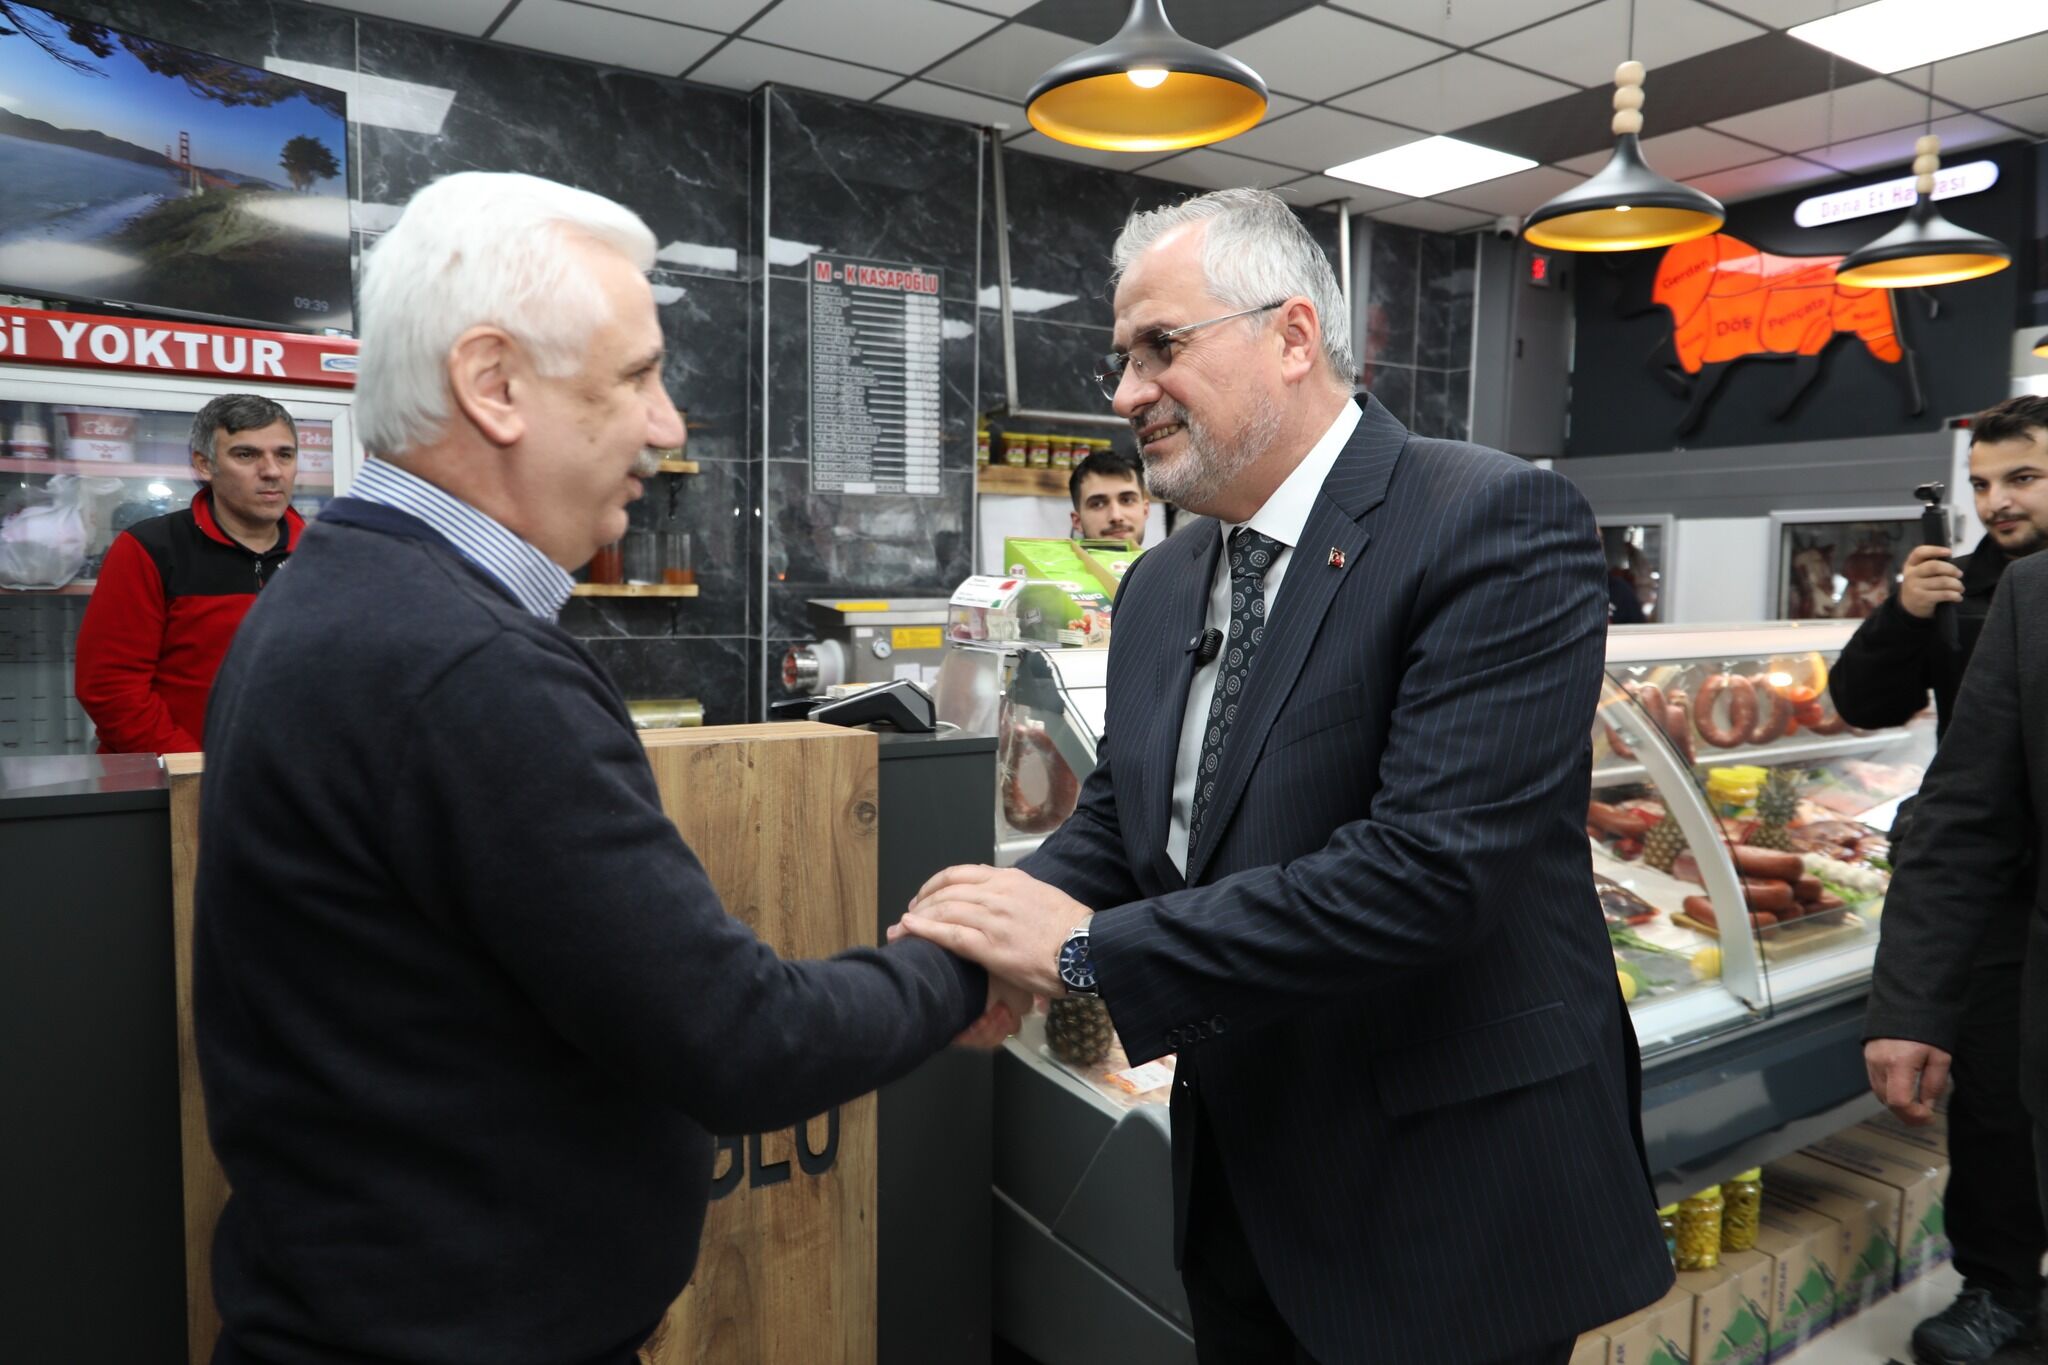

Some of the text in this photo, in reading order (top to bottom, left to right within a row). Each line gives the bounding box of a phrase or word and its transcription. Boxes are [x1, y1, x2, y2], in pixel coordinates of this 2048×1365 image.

[1820, 199, 1861, 219] Dana
[1868, 190, 1884, 209] Et
[815, 260, 832, 282] M
[844, 264, 858, 285] K
[858, 266, 939, 294] KASAPOĞLU
[1661, 258, 1710, 291] Gerdan
[293, 295, 330, 314] 09:39
[1716, 314, 1753, 338] Döş
[47, 318, 287, 377] YOKTUR
